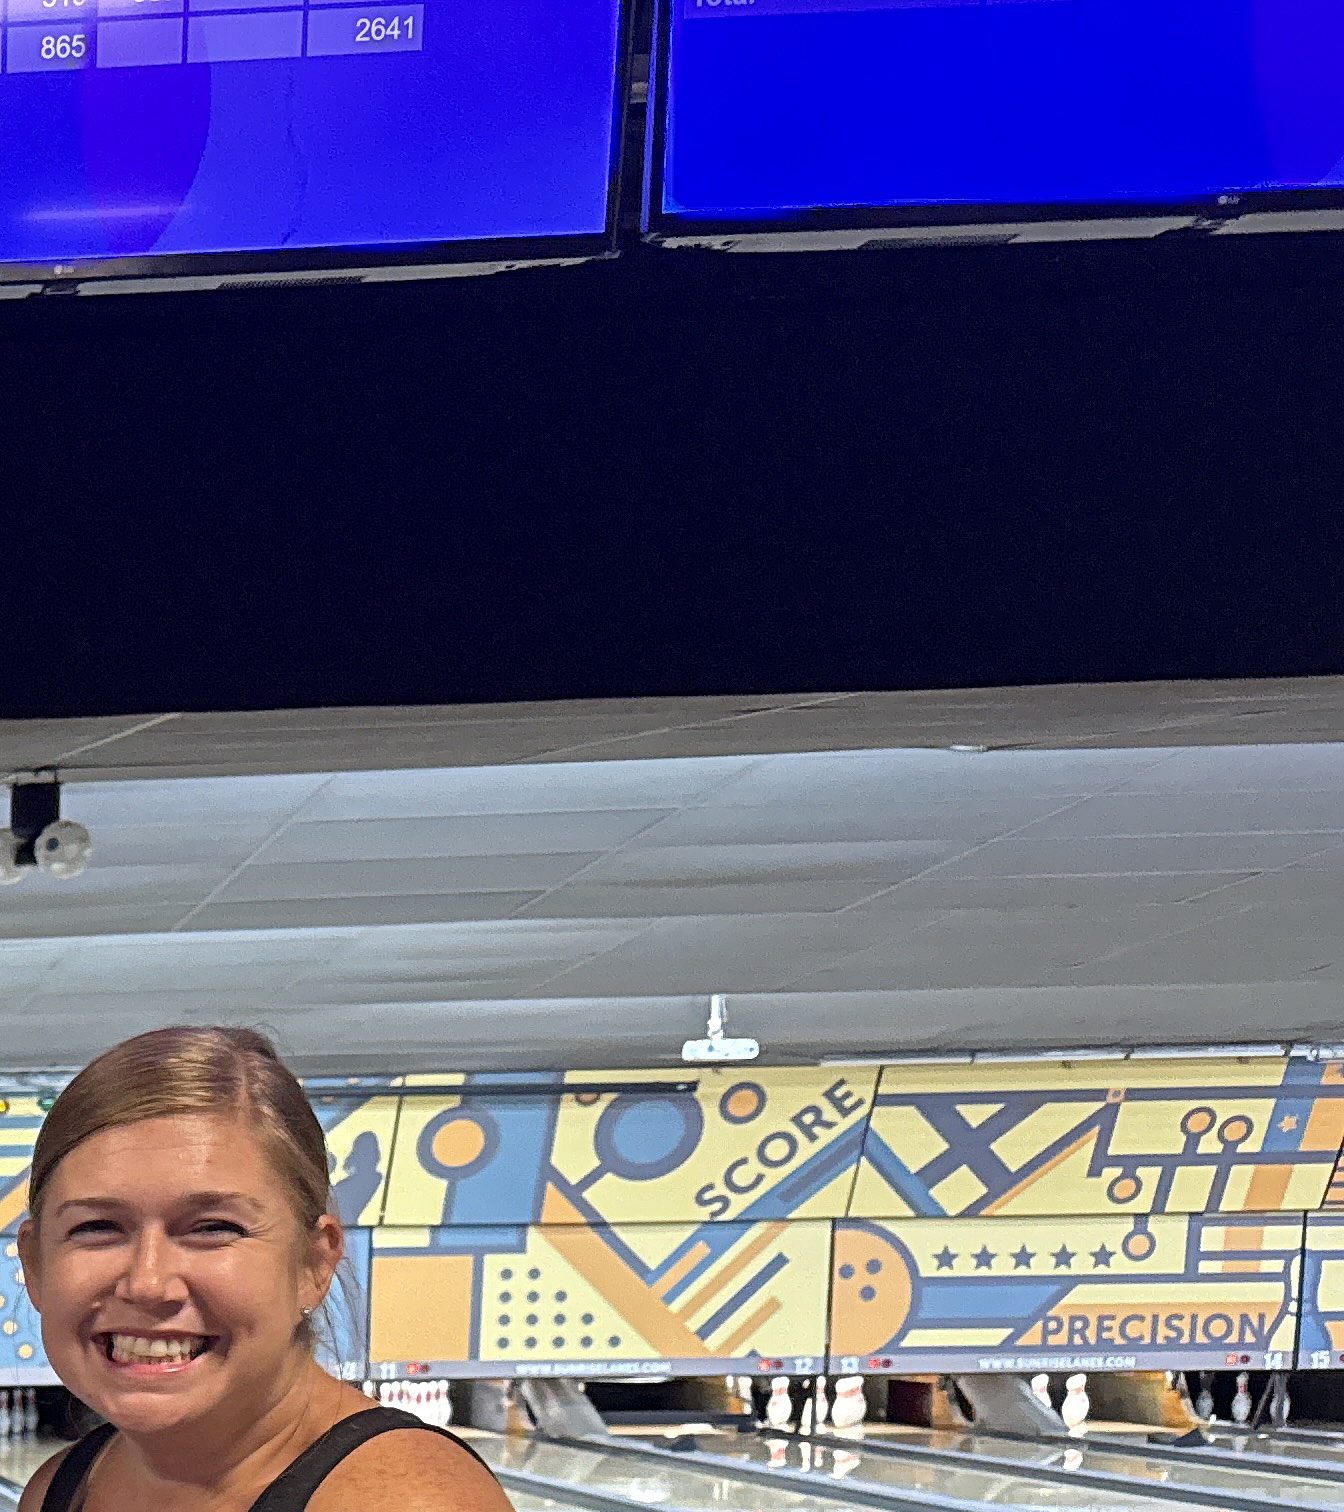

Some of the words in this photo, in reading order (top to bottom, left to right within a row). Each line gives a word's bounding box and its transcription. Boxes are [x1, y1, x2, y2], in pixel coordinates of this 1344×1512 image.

[355, 15, 416, 43] 2641
[41, 35, 86, 60] 865
[693, 1077, 864, 1219] SCORE
[1041, 1311, 1269, 1346] PRECISION
